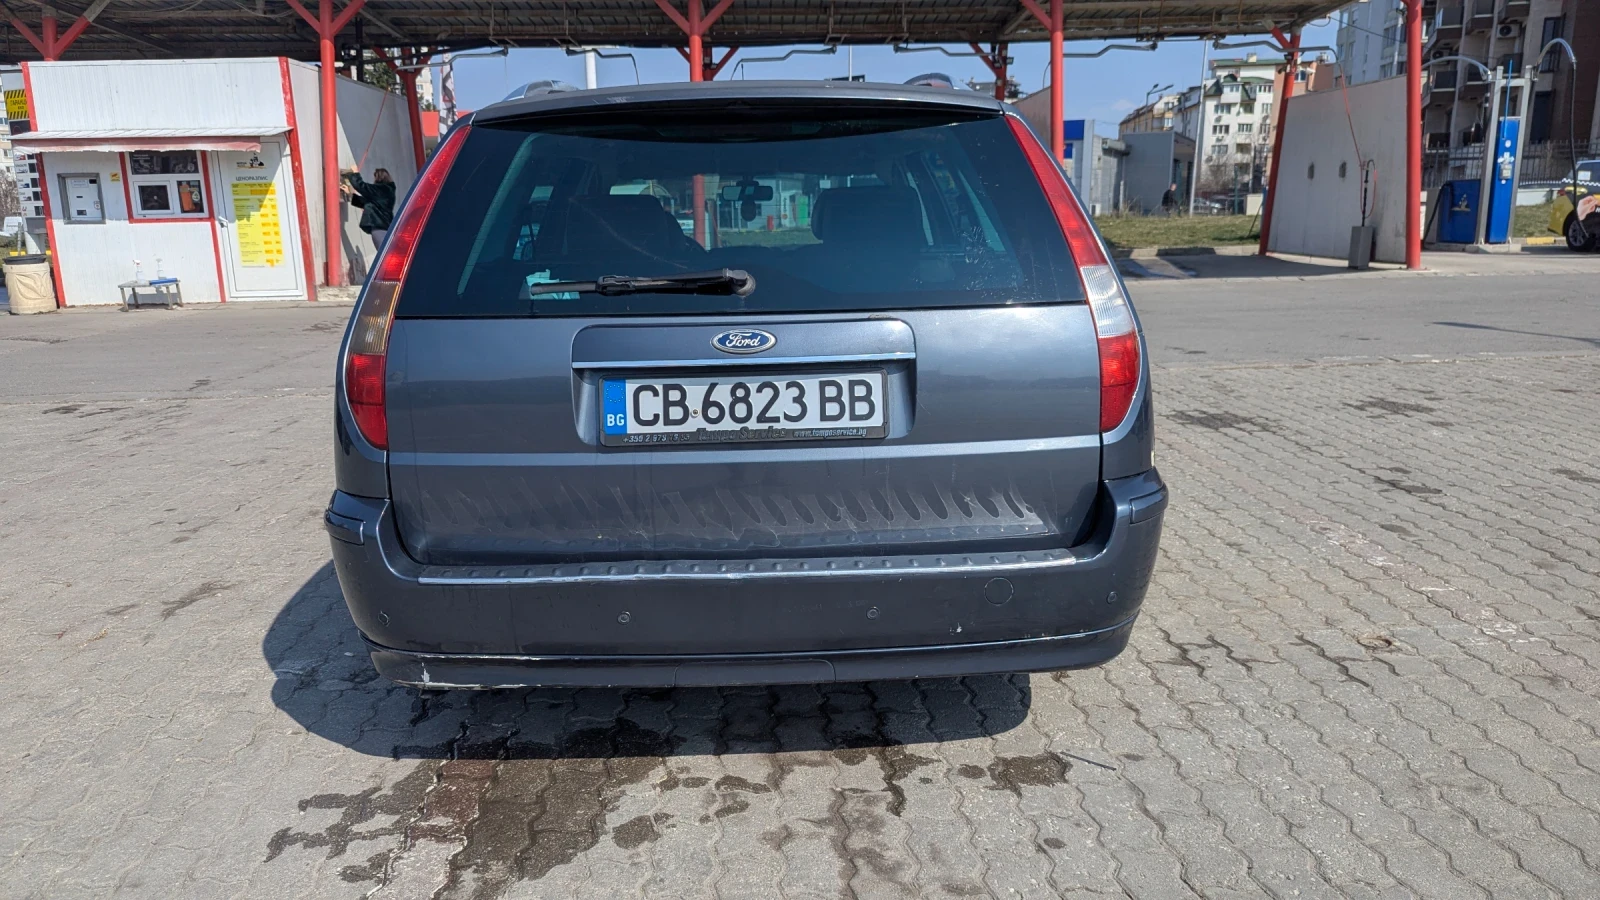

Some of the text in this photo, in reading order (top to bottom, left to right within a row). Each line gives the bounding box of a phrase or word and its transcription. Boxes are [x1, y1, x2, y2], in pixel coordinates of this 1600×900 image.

[725, 333, 761, 347] Ford
[701, 380, 808, 425] 6823
[606, 413, 625, 427] BG
[740, 425, 787, 439] Service
